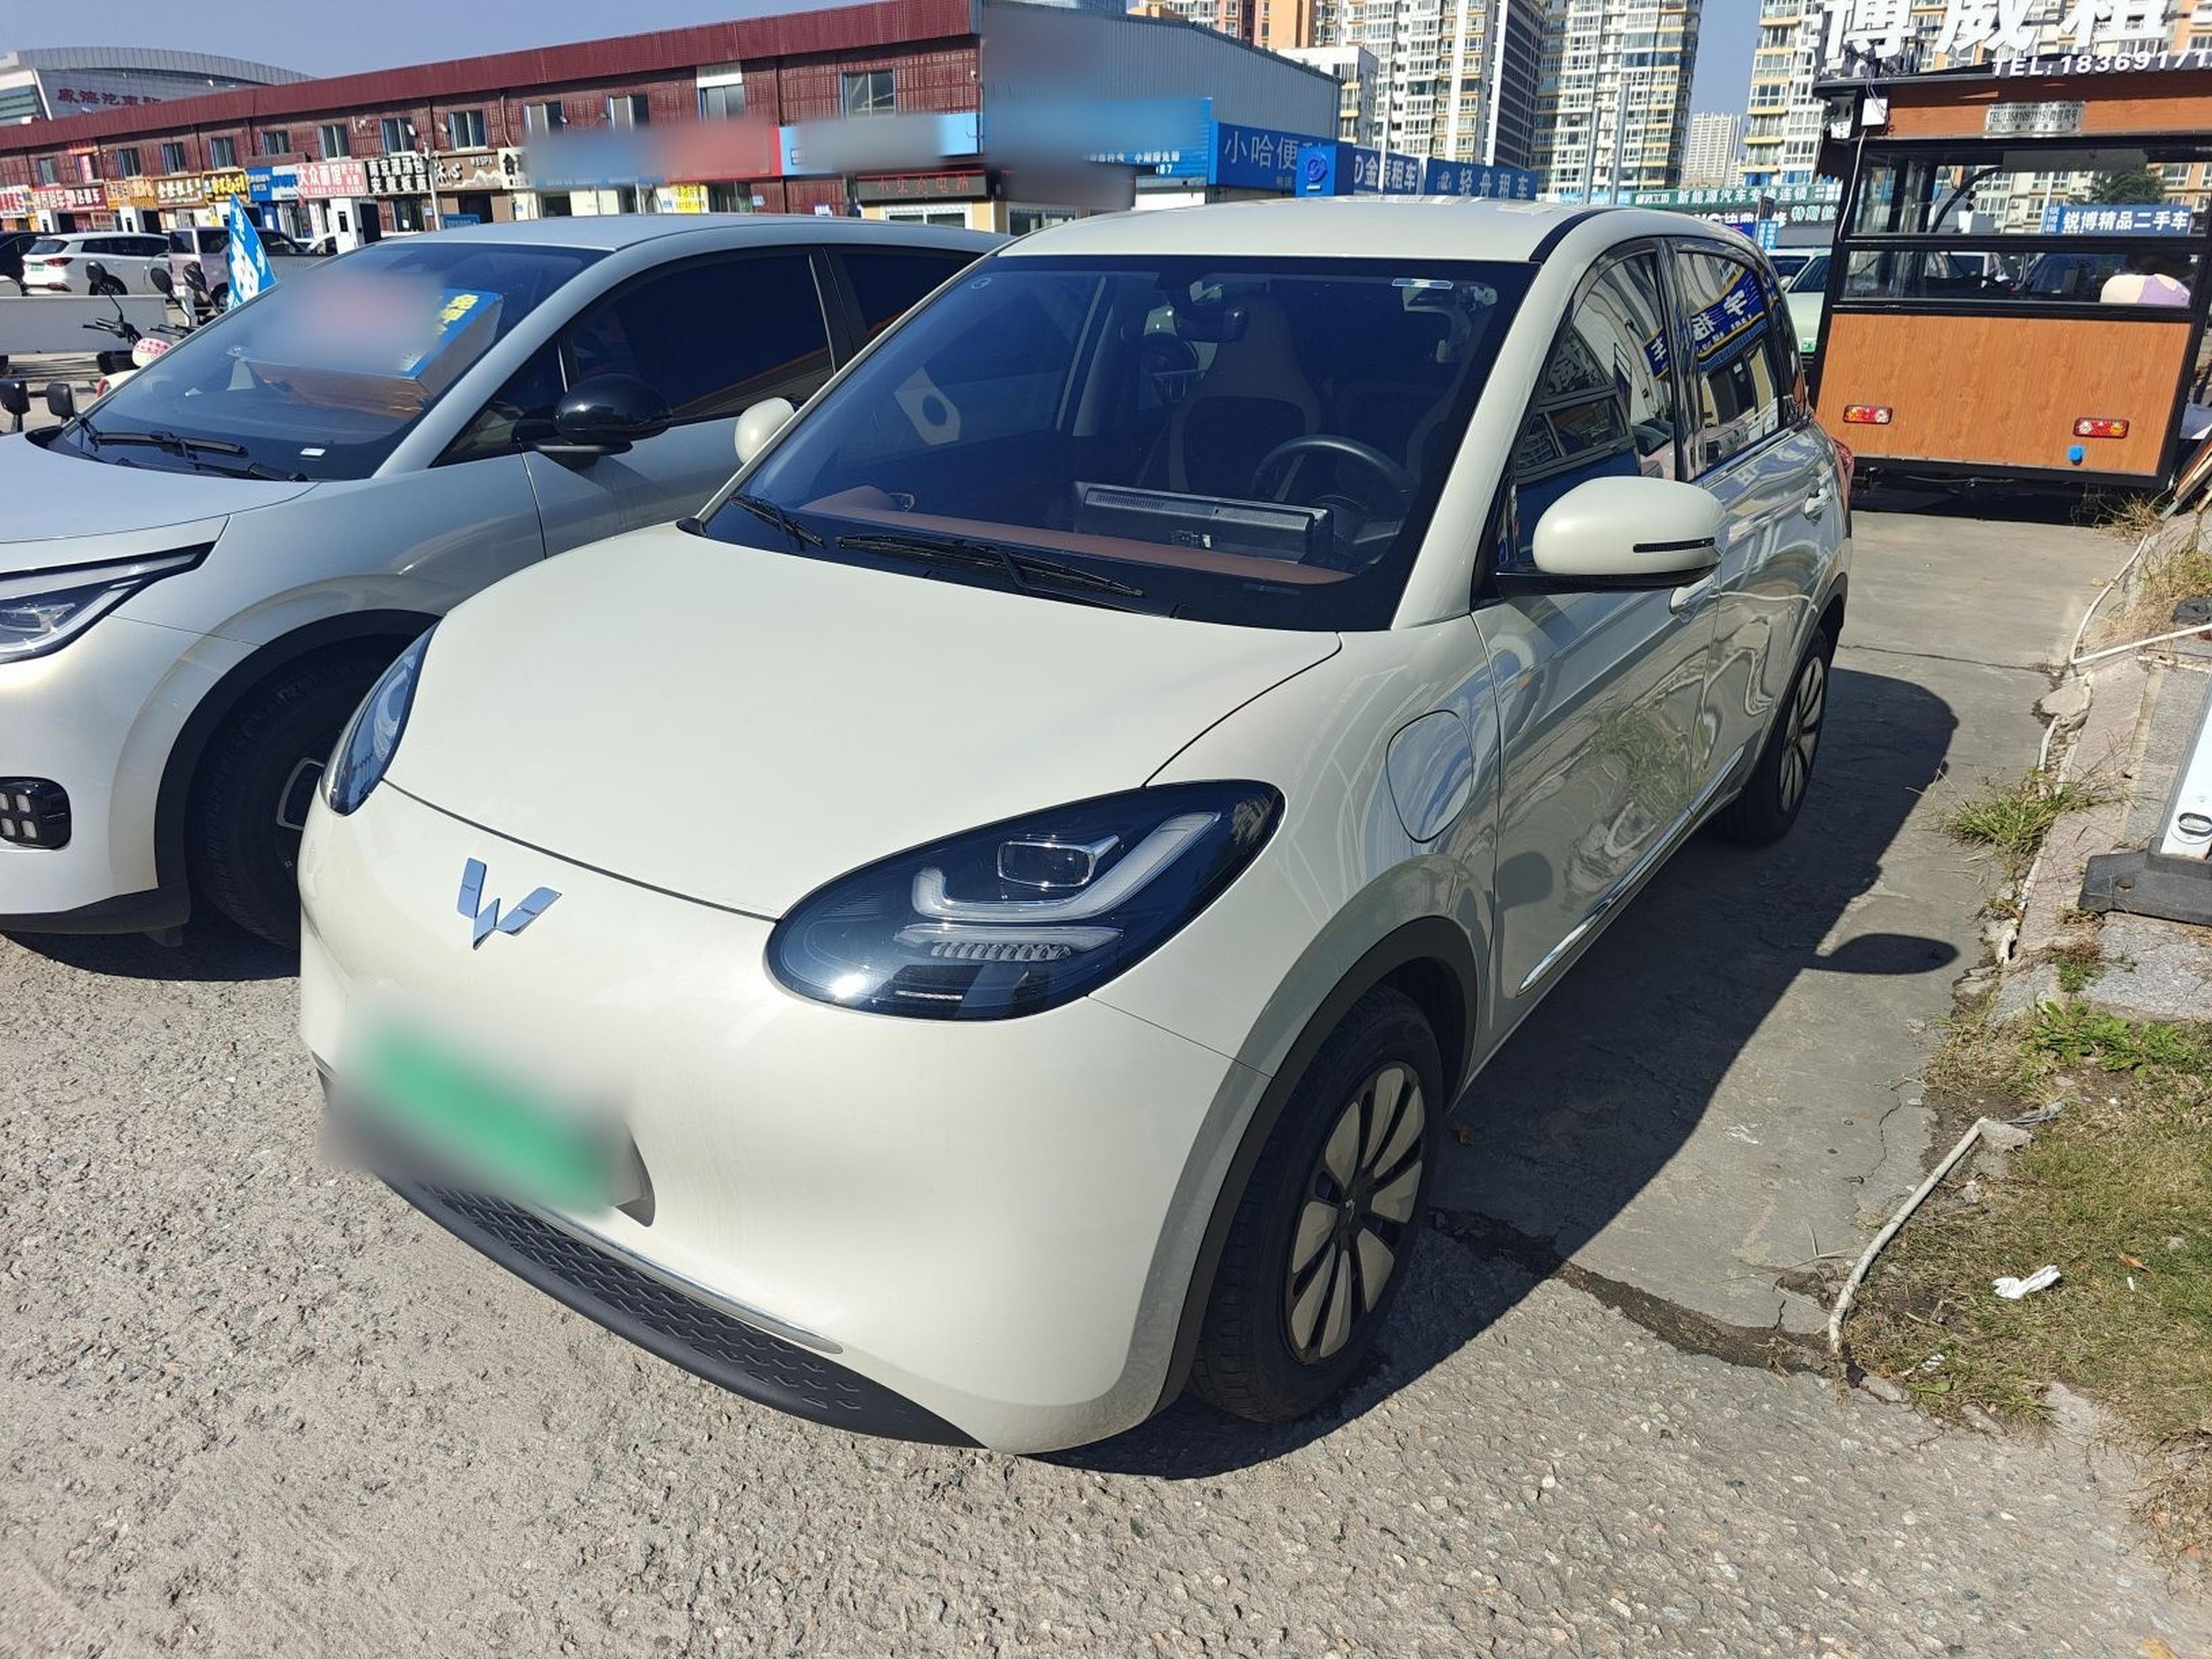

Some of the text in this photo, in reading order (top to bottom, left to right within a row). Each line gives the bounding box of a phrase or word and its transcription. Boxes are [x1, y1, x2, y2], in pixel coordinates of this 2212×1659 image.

[1992, 50, 2212, 77] TEL:18369171
[1225, 131, 1321, 170] 小哈便
[2062, 210, 2189, 231] 锐博精品二手车
